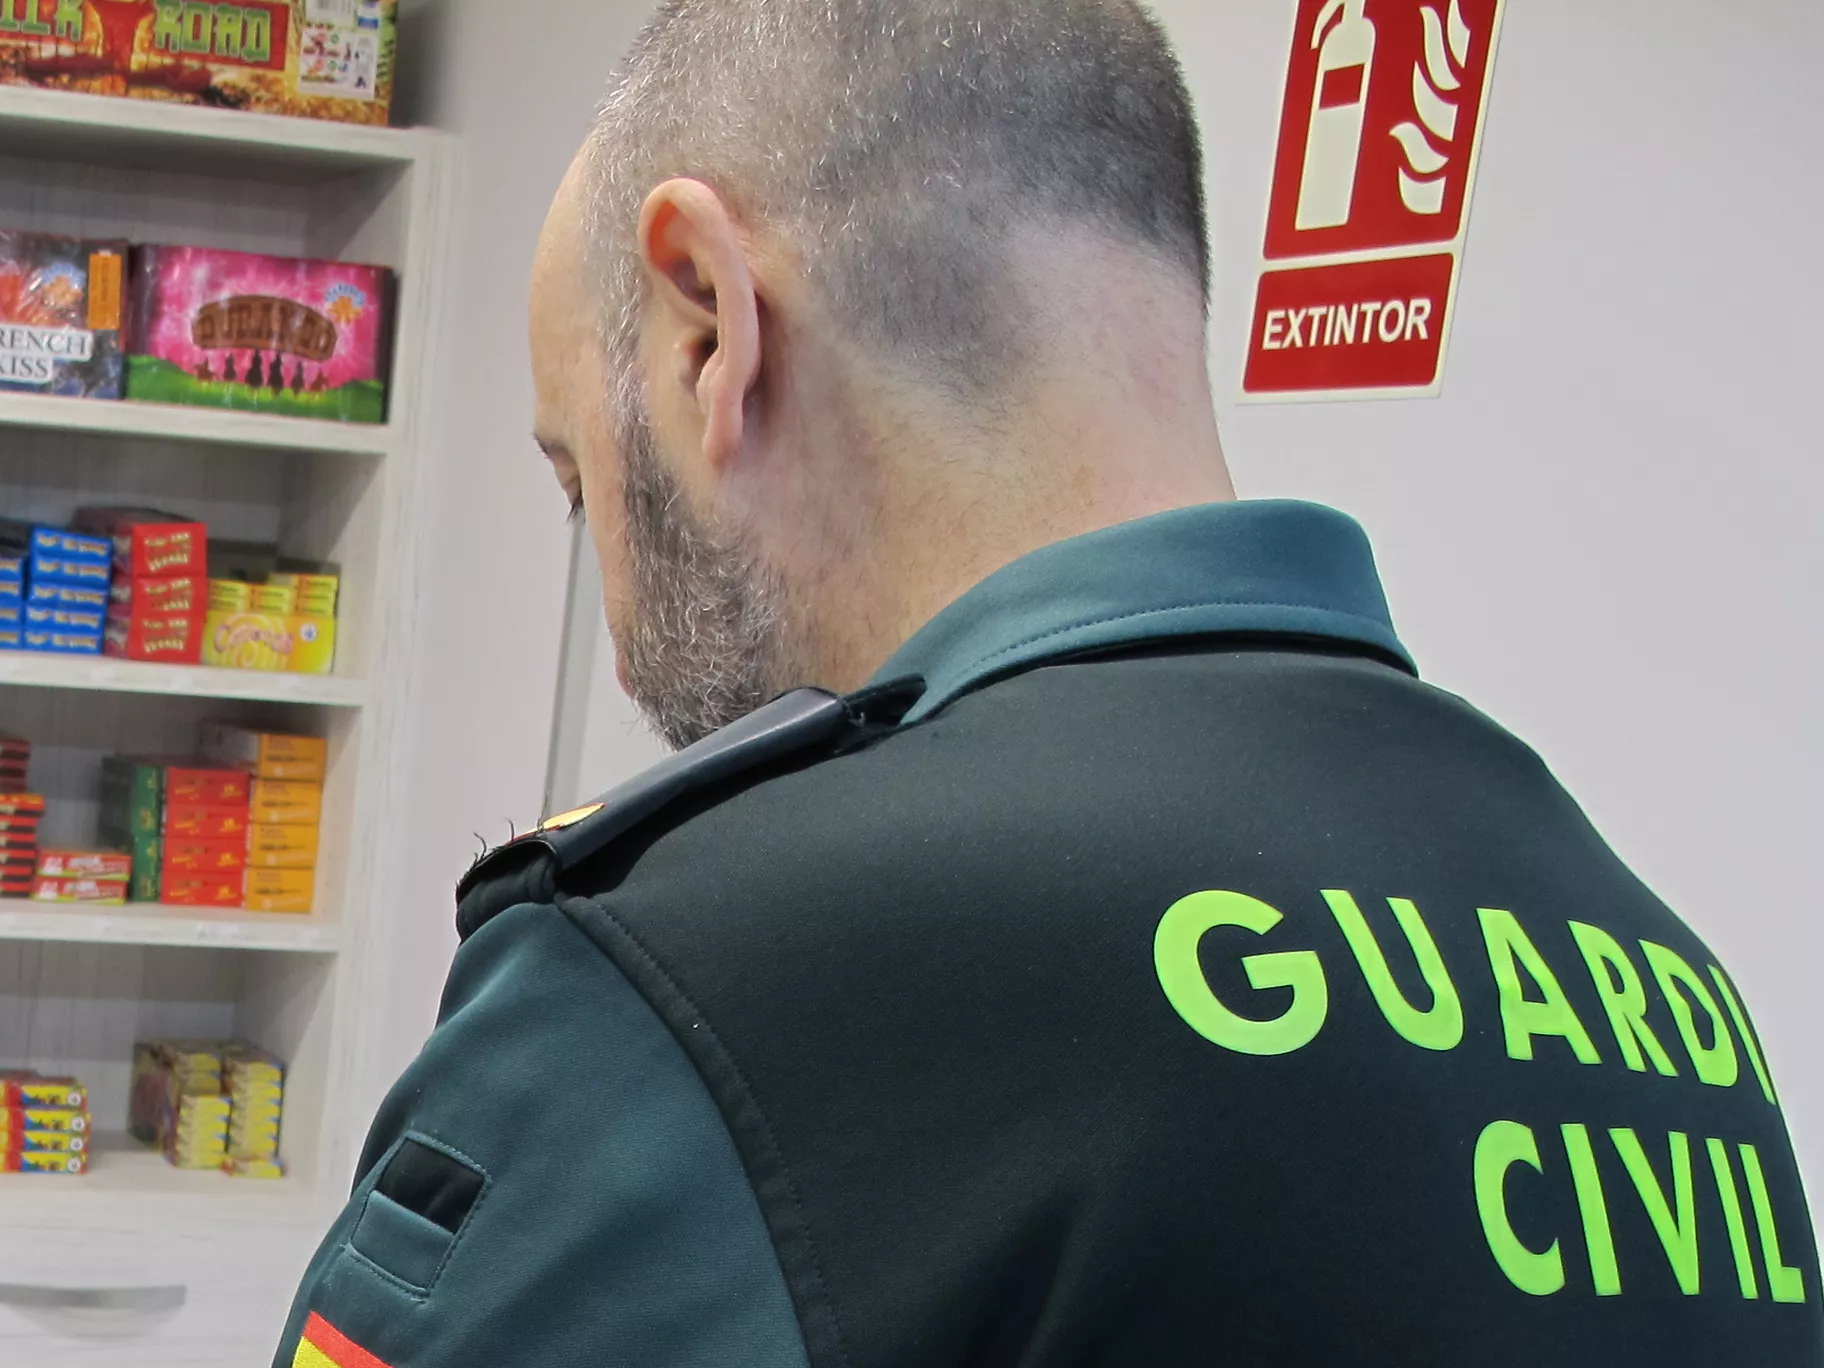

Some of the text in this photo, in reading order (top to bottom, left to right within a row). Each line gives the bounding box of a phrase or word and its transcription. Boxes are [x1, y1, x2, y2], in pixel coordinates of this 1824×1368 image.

[154, 0, 272, 62] ROAD
[1262, 298, 1432, 351] EXTINTOR
[1473, 1119, 1807, 1305] CIVIL
